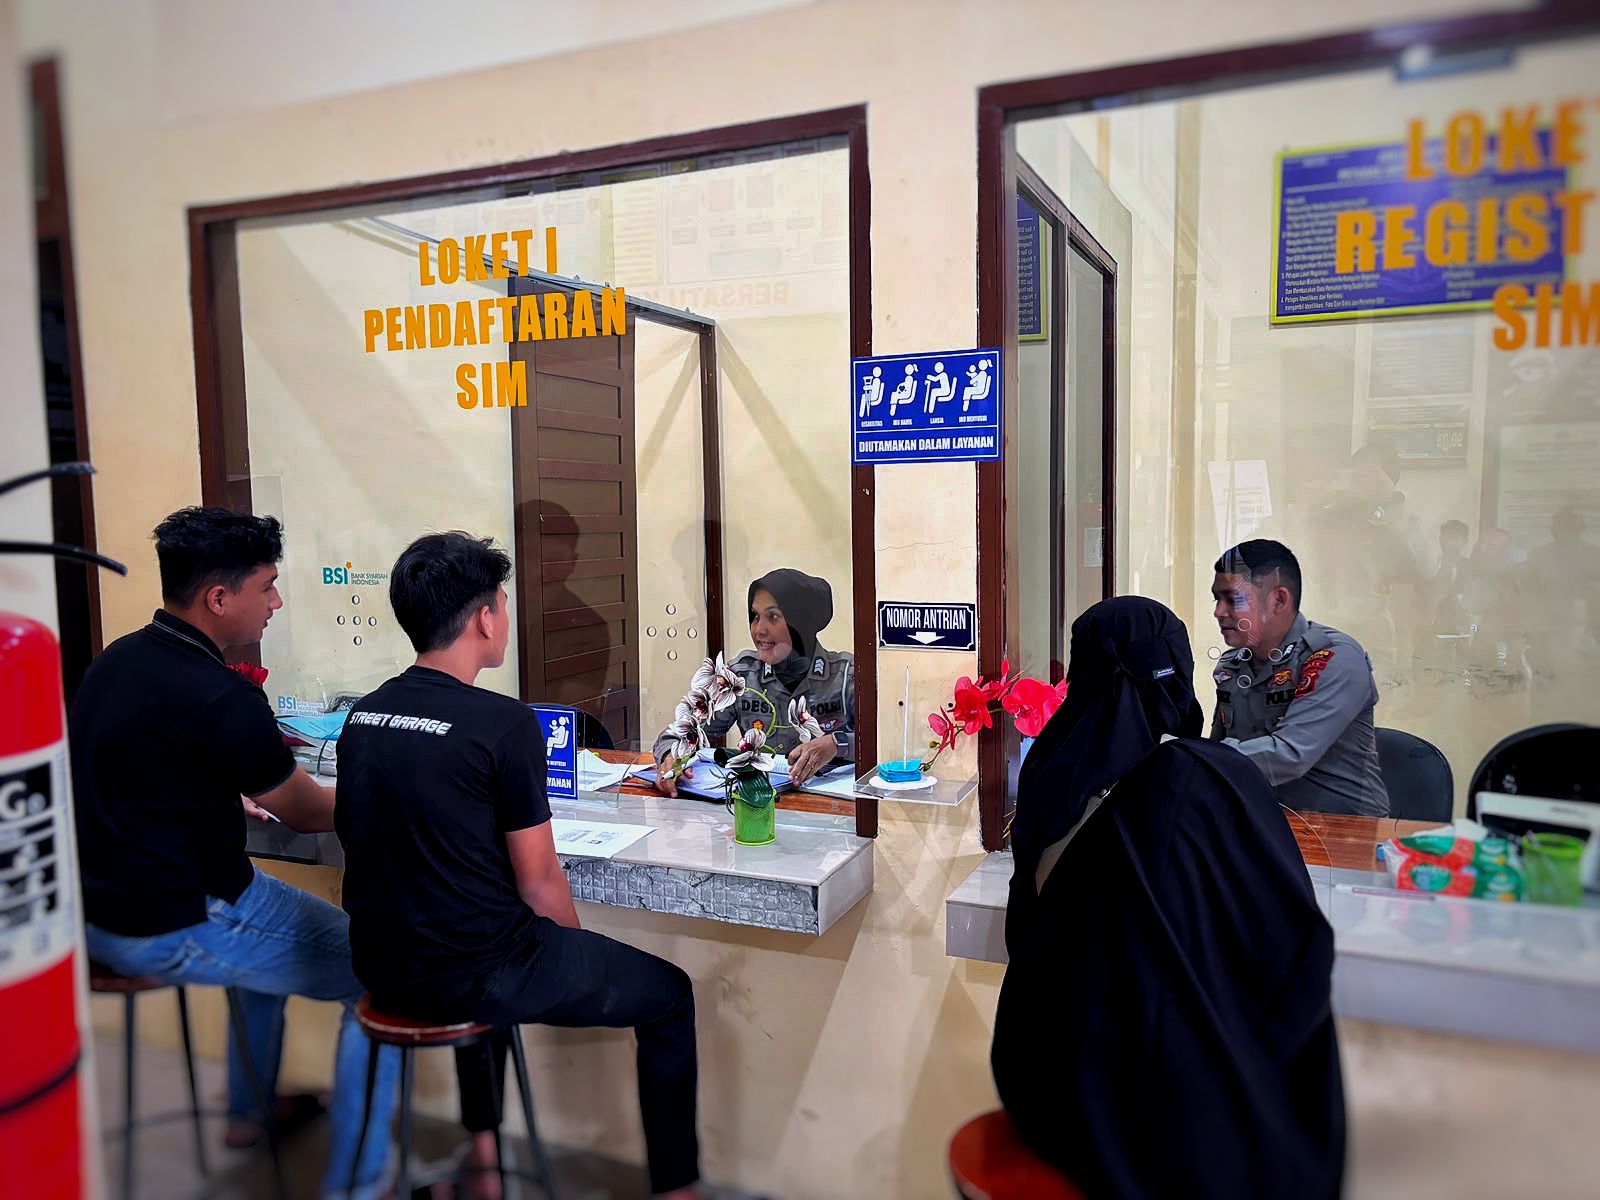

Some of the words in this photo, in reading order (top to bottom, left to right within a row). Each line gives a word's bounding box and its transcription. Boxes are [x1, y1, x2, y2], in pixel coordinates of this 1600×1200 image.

[1407, 97, 1600, 181] LOKE
[1335, 191, 1596, 273] REGIST
[419, 229, 533, 286] LOKET
[364, 287, 627, 353] PENDAFTARAN
[1493, 283, 1600, 351] SIM
[456, 360, 529, 410] SIM
[859, 440, 917, 453] DIUTAMAKAN
[919, 438, 950, 450] DALAM
[953, 436, 994, 449] LAYANAN
[322, 566, 349, 585] BSI
[886, 607, 921, 629] NOMOR
[923, 608, 966, 630] ANTRIAN
[278, 695, 296, 710] BSI
[350, 711, 393, 727] STREET
[389, 714, 452, 736] GARAGE
[547, 777, 572, 789] YANAN
